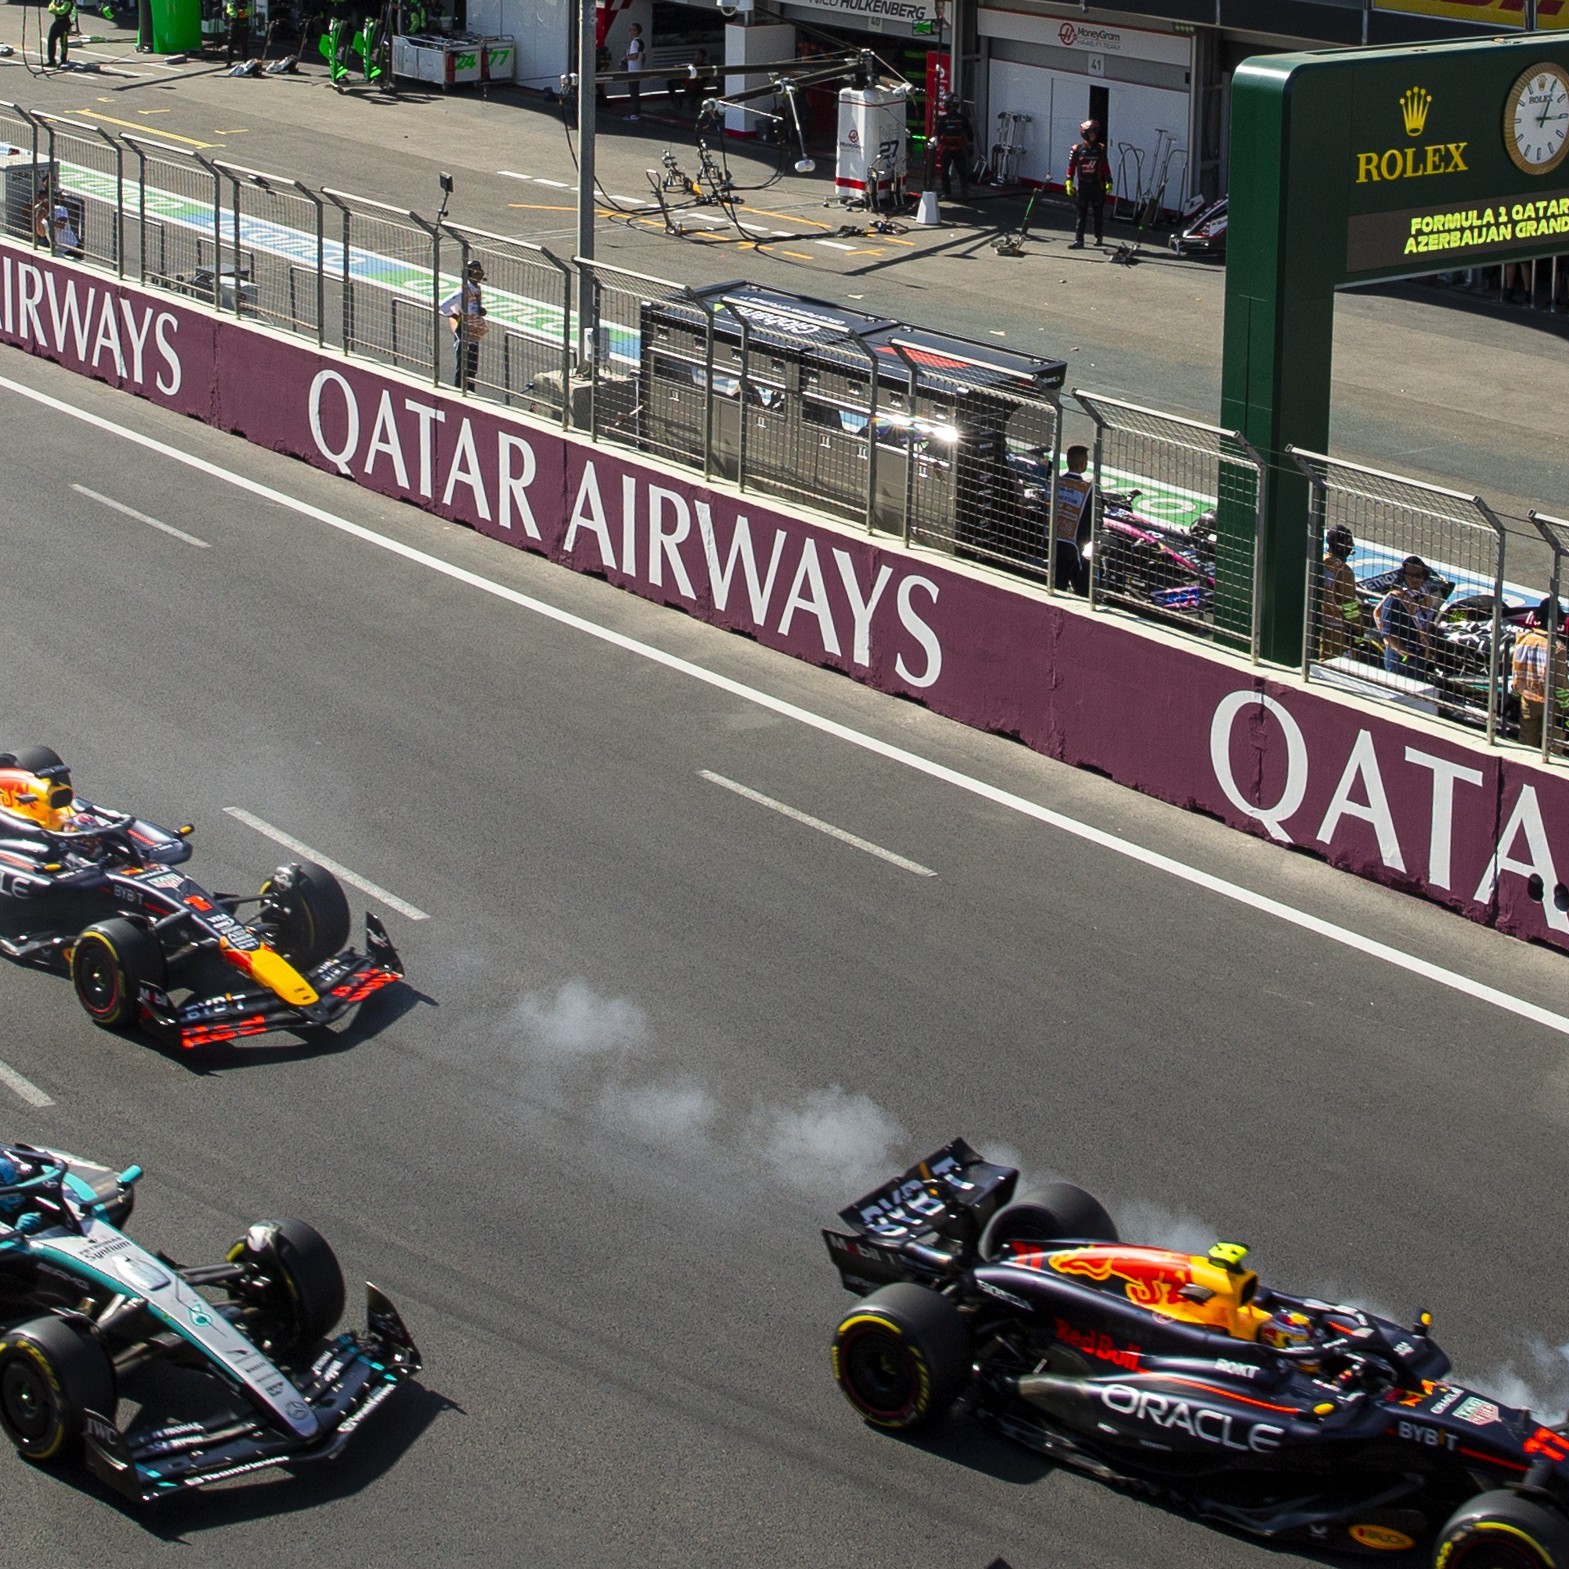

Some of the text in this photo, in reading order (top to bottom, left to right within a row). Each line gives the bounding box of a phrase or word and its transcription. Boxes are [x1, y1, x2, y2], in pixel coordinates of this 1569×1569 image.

[1077, 26, 1121, 42] MoneyGram
[457, 52, 477, 70] 24
[488, 49, 511, 67] 77
[1091, 59, 1101, 71] 41
[1528, 94, 1554, 105] ROLEX
[879, 139, 899, 160] 27
[1355, 142, 1469, 184] ROLEX
[1411, 207, 1493, 235] FORMULA
[1498, 206, 1508, 224] 1
[1404, 223, 1512, 255] AZERBAIJAN
[308, 368, 943, 689] QATAR AIRWAYS
[113, 885, 145, 906] BYBIT
[1054, 1317, 1096, 1354] Red
[1099, 1383, 1286, 1454] ORACLE
[1398, 1420, 1460, 1452] BYBIT
